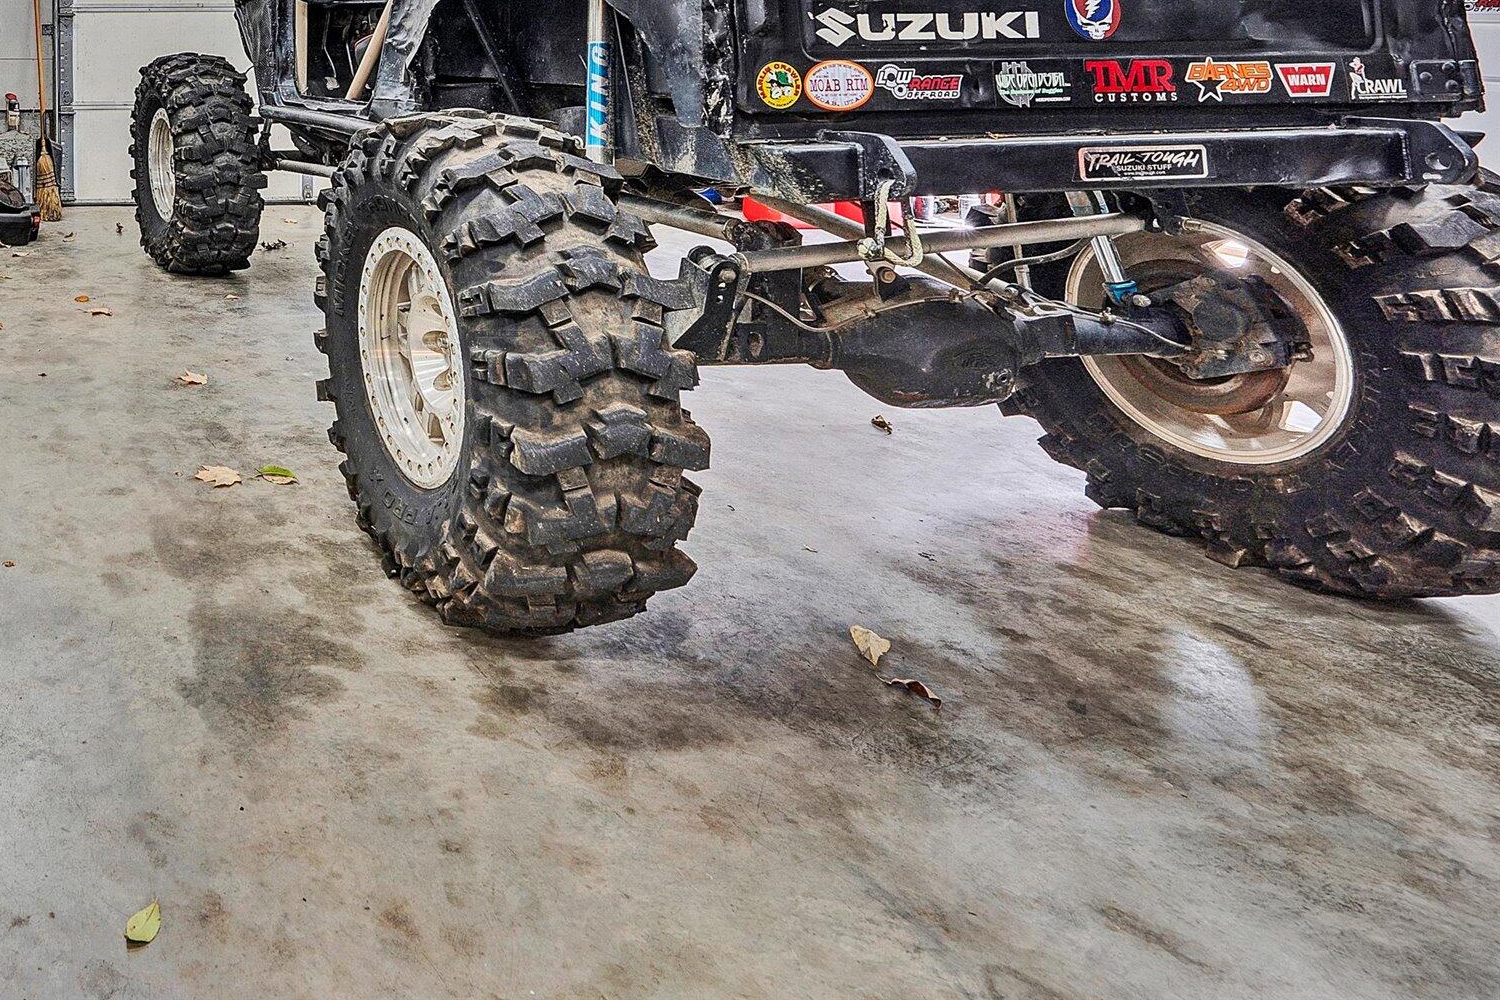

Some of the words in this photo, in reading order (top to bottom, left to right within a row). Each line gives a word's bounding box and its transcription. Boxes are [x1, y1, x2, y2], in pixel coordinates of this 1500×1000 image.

[815, 7, 1040, 47] SUZUKI
[1084, 59, 1177, 93] TMR
[1188, 59, 1272, 80] BARNES
[810, 78, 841, 92] MOAB
[846, 78, 869, 91] RIM
[877, 66, 913, 90] LOW
[908, 76, 960, 91] RANGE
[1220, 77, 1270, 92] 4WD
[1287, 73, 1327, 86] WARN
[1356, 78, 1407, 94] CRAWL
[589, 45, 610, 143] KING
[906, 90, 960, 99] OFF-ROAD
[1094, 91, 1178, 103] CUSTOMS
[1086, 152, 1136, 172] TRAIL
[1138, 150, 1200, 168] TOUGH
[1116, 164, 1146, 172] SUZUKI
[1146, 163, 1173, 171] STUFF
